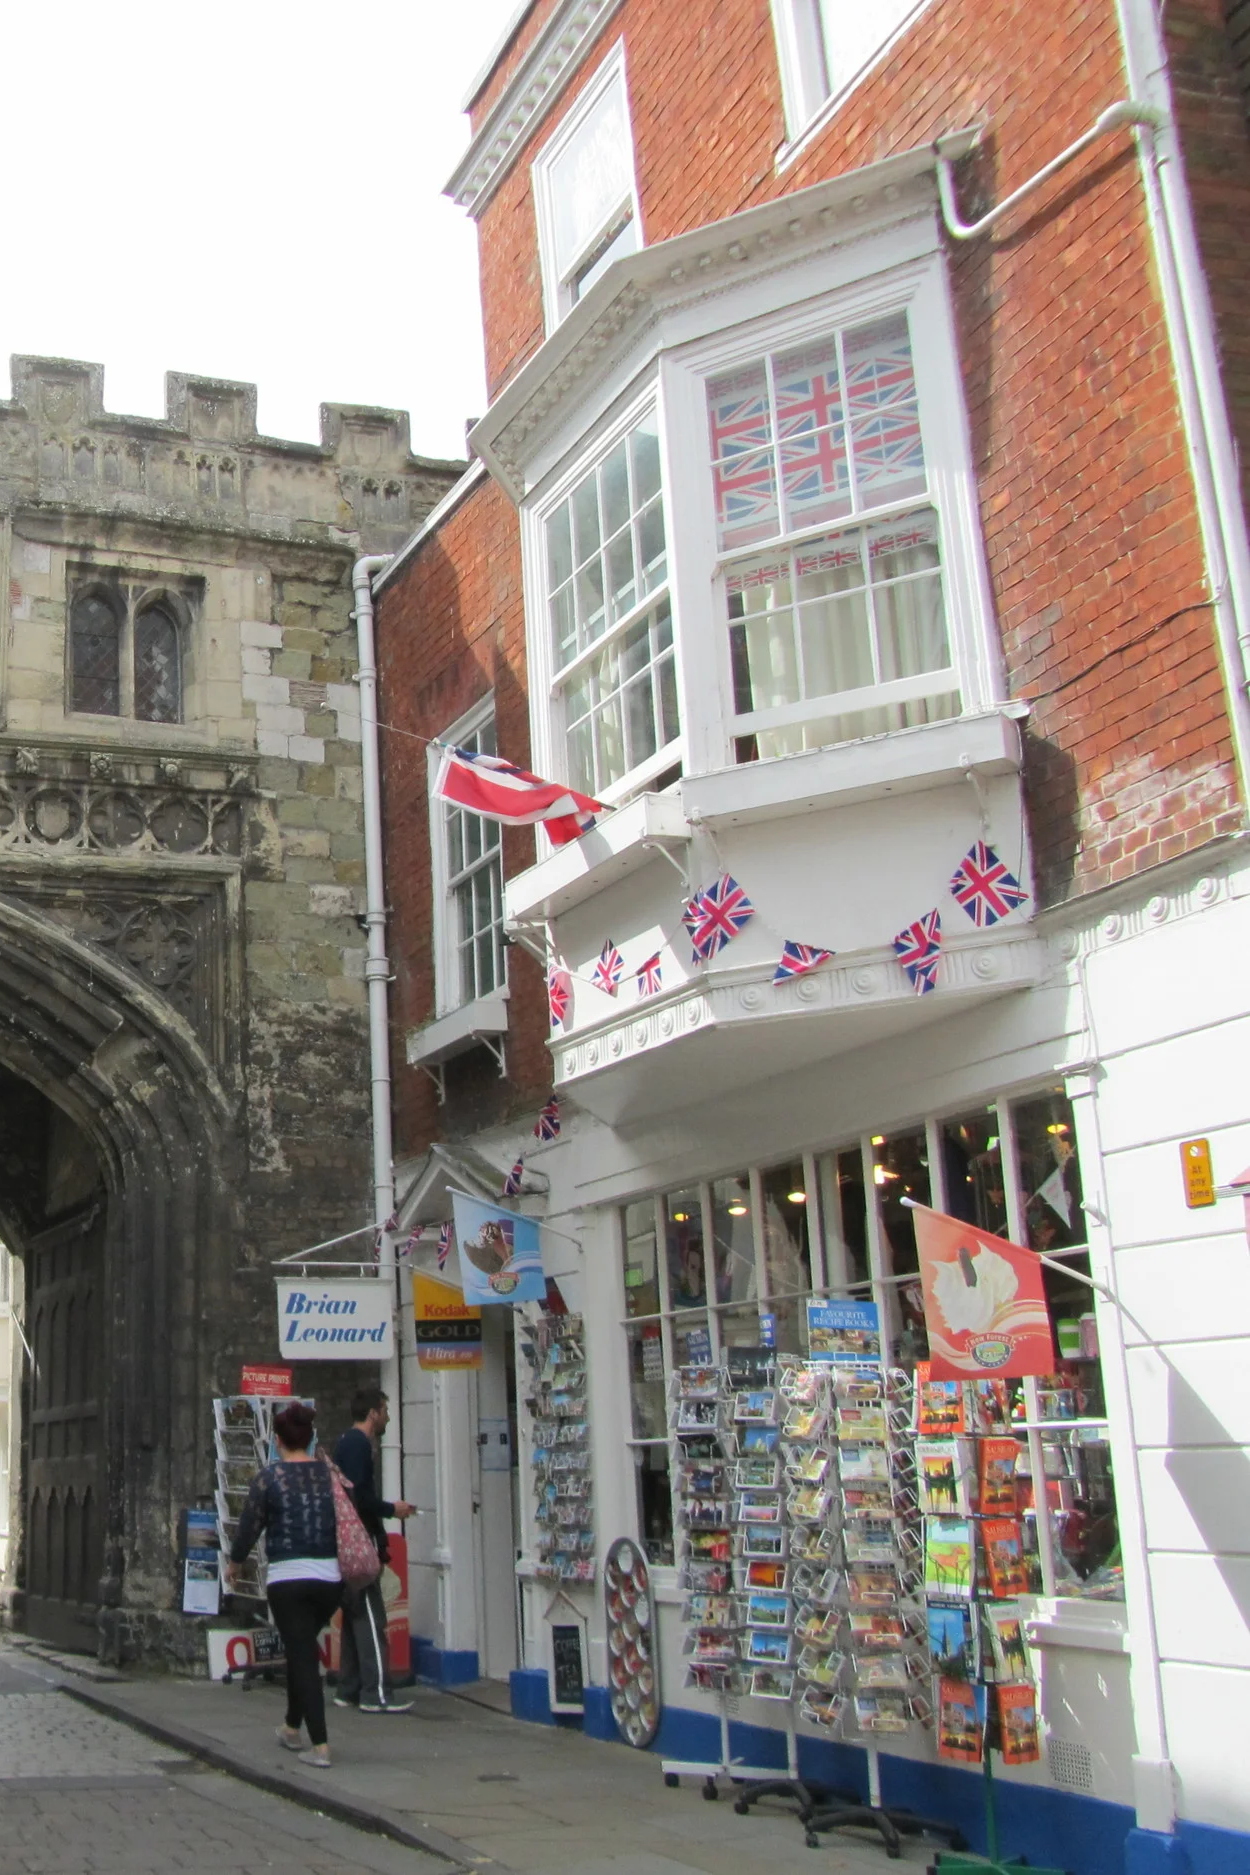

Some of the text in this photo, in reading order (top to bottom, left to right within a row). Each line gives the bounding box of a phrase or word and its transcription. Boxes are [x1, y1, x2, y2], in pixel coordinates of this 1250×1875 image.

[1190, 1190, 1210, 1200] time
[285, 1292, 358, 1314] Brian
[423, 1304, 470, 1317] Kodak
[820, 1309, 867, 1320] FAVOURITE
[813, 1316, 875, 1328] RECIPE BOOKS
[285, 1320, 387, 1343] Leonard
[417, 1325, 480, 1338] GOLD
[426, 1347, 456, 1360] Ultra
[242, 1371, 290, 1385] PICTURE PRINTS
